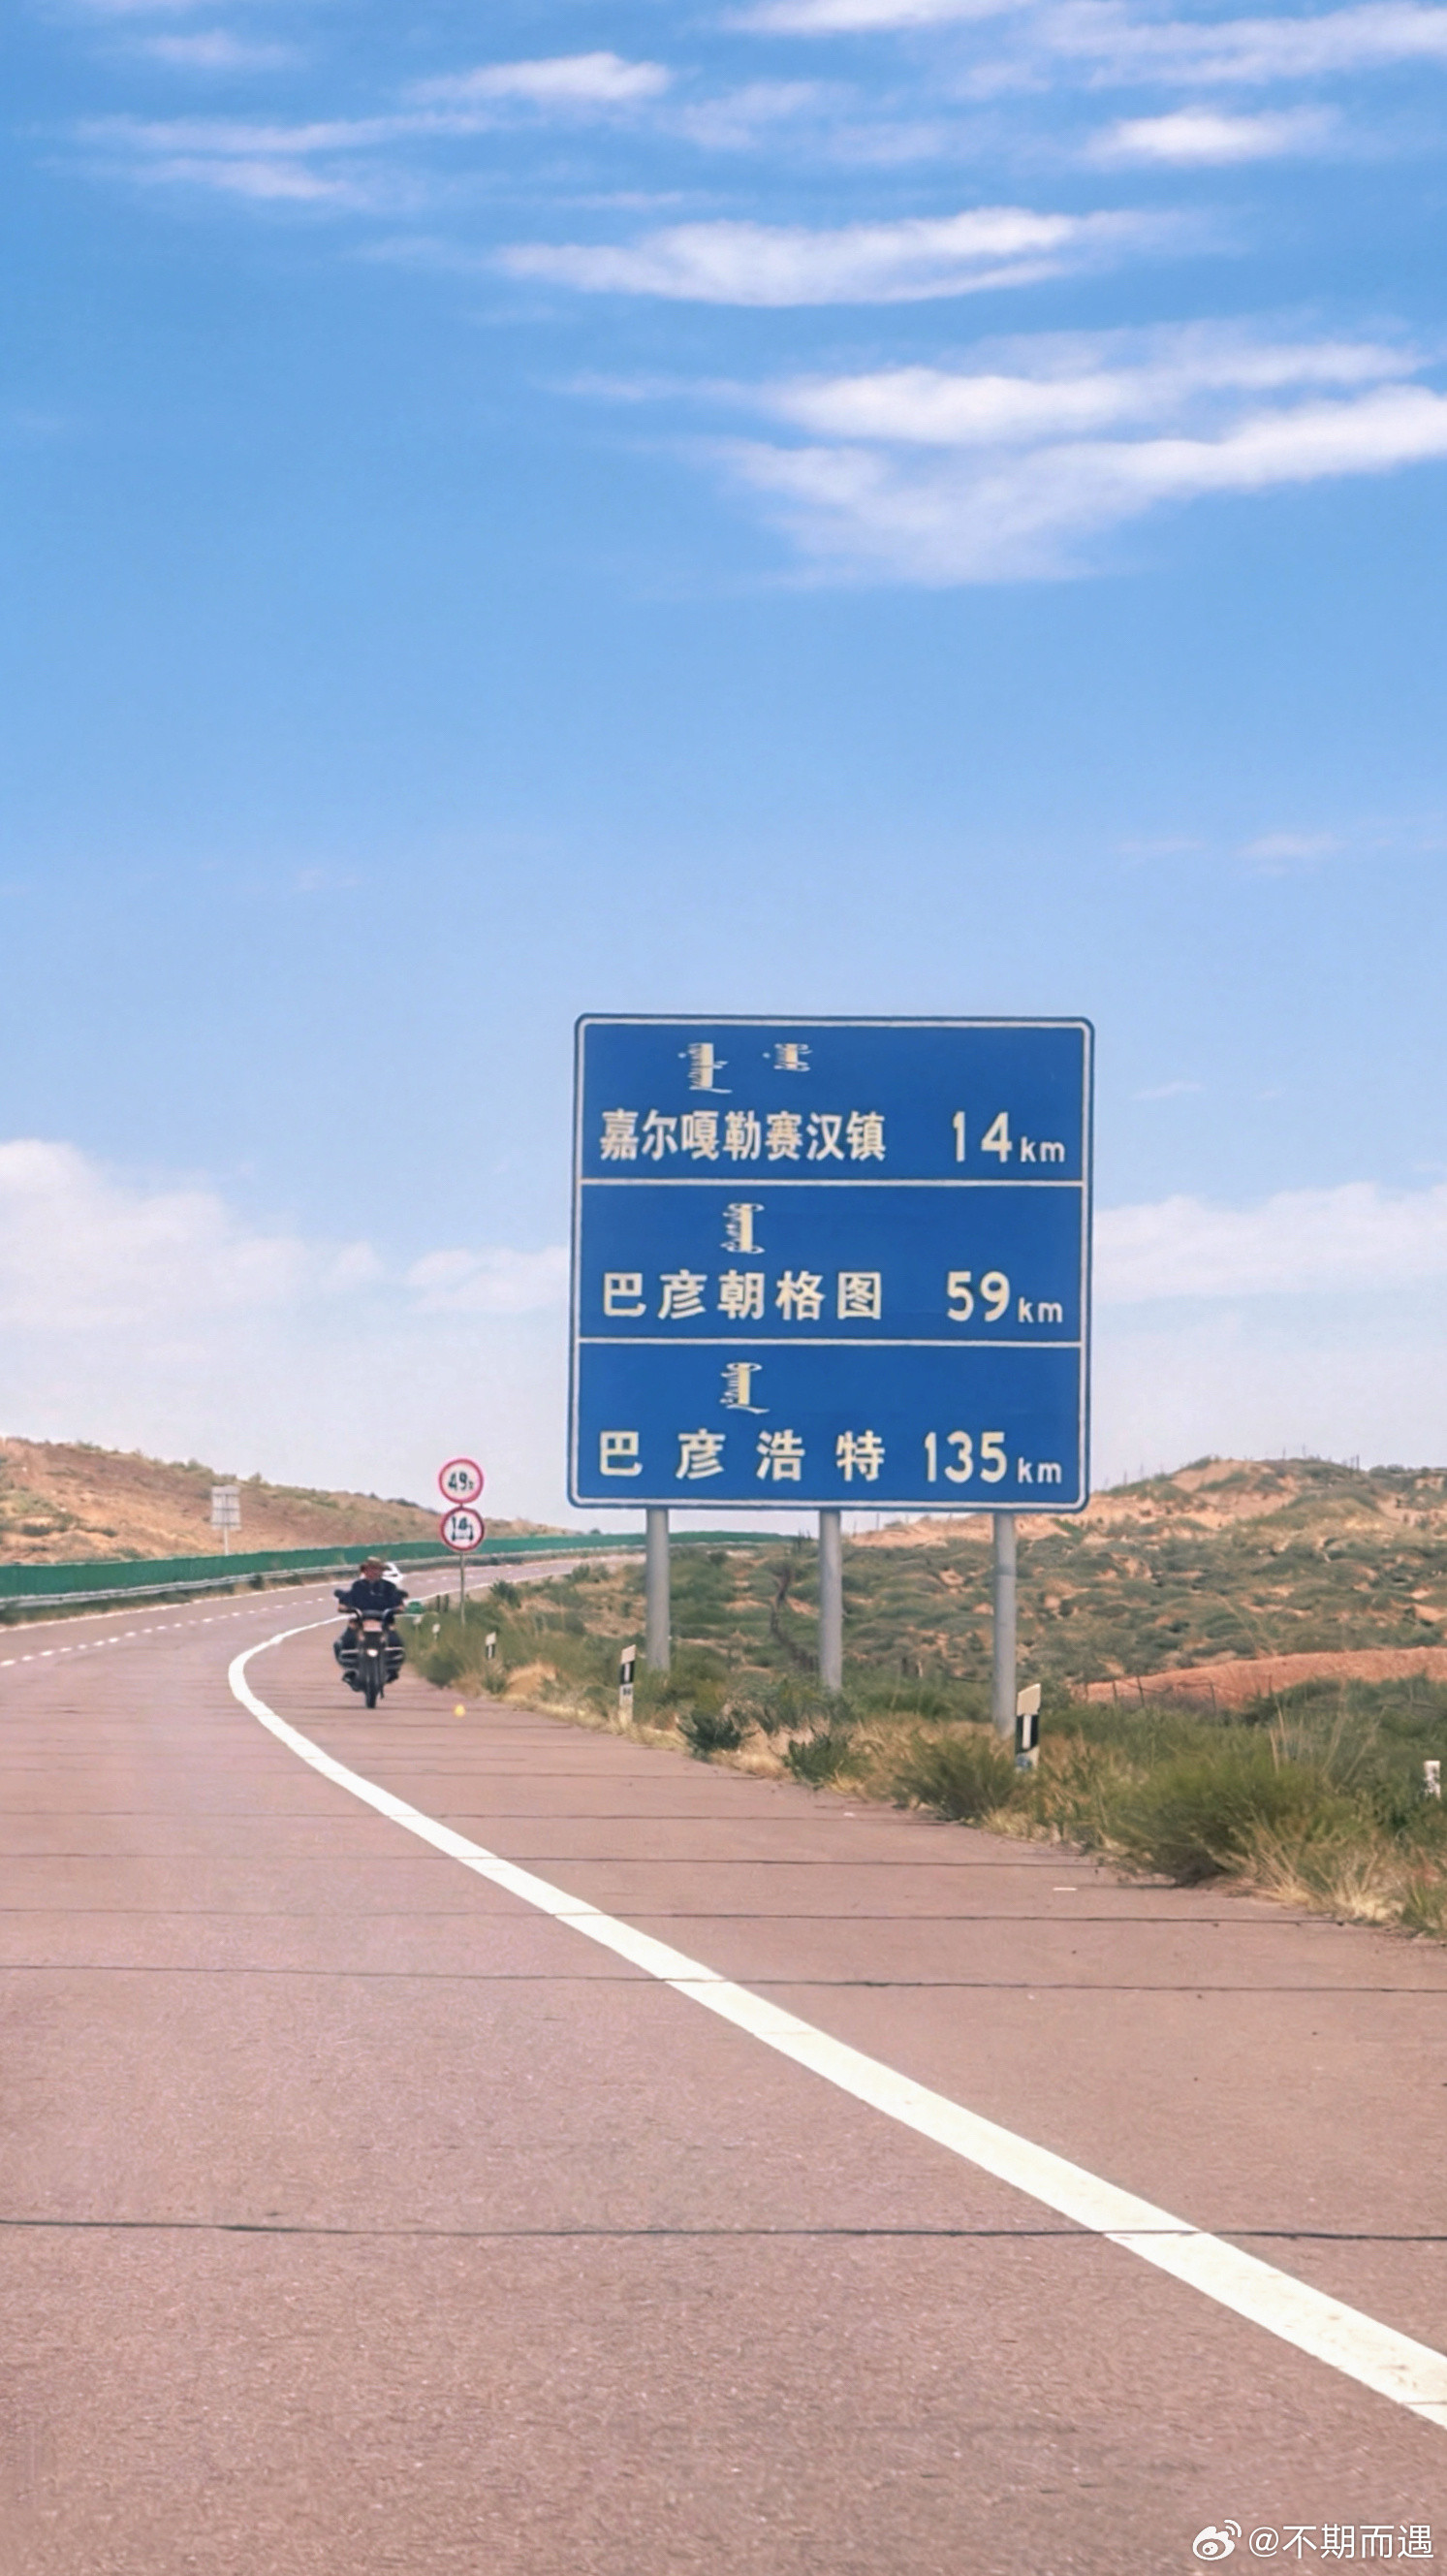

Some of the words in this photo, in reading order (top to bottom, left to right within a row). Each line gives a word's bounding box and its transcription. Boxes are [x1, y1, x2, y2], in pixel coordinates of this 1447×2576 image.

[599, 1108, 886, 1161] 嘉尔嘎勒赛汉镇
[603, 1269, 882, 1320] 巴彦朝格图
[599, 1428, 885, 1481] 巴彦浩特
